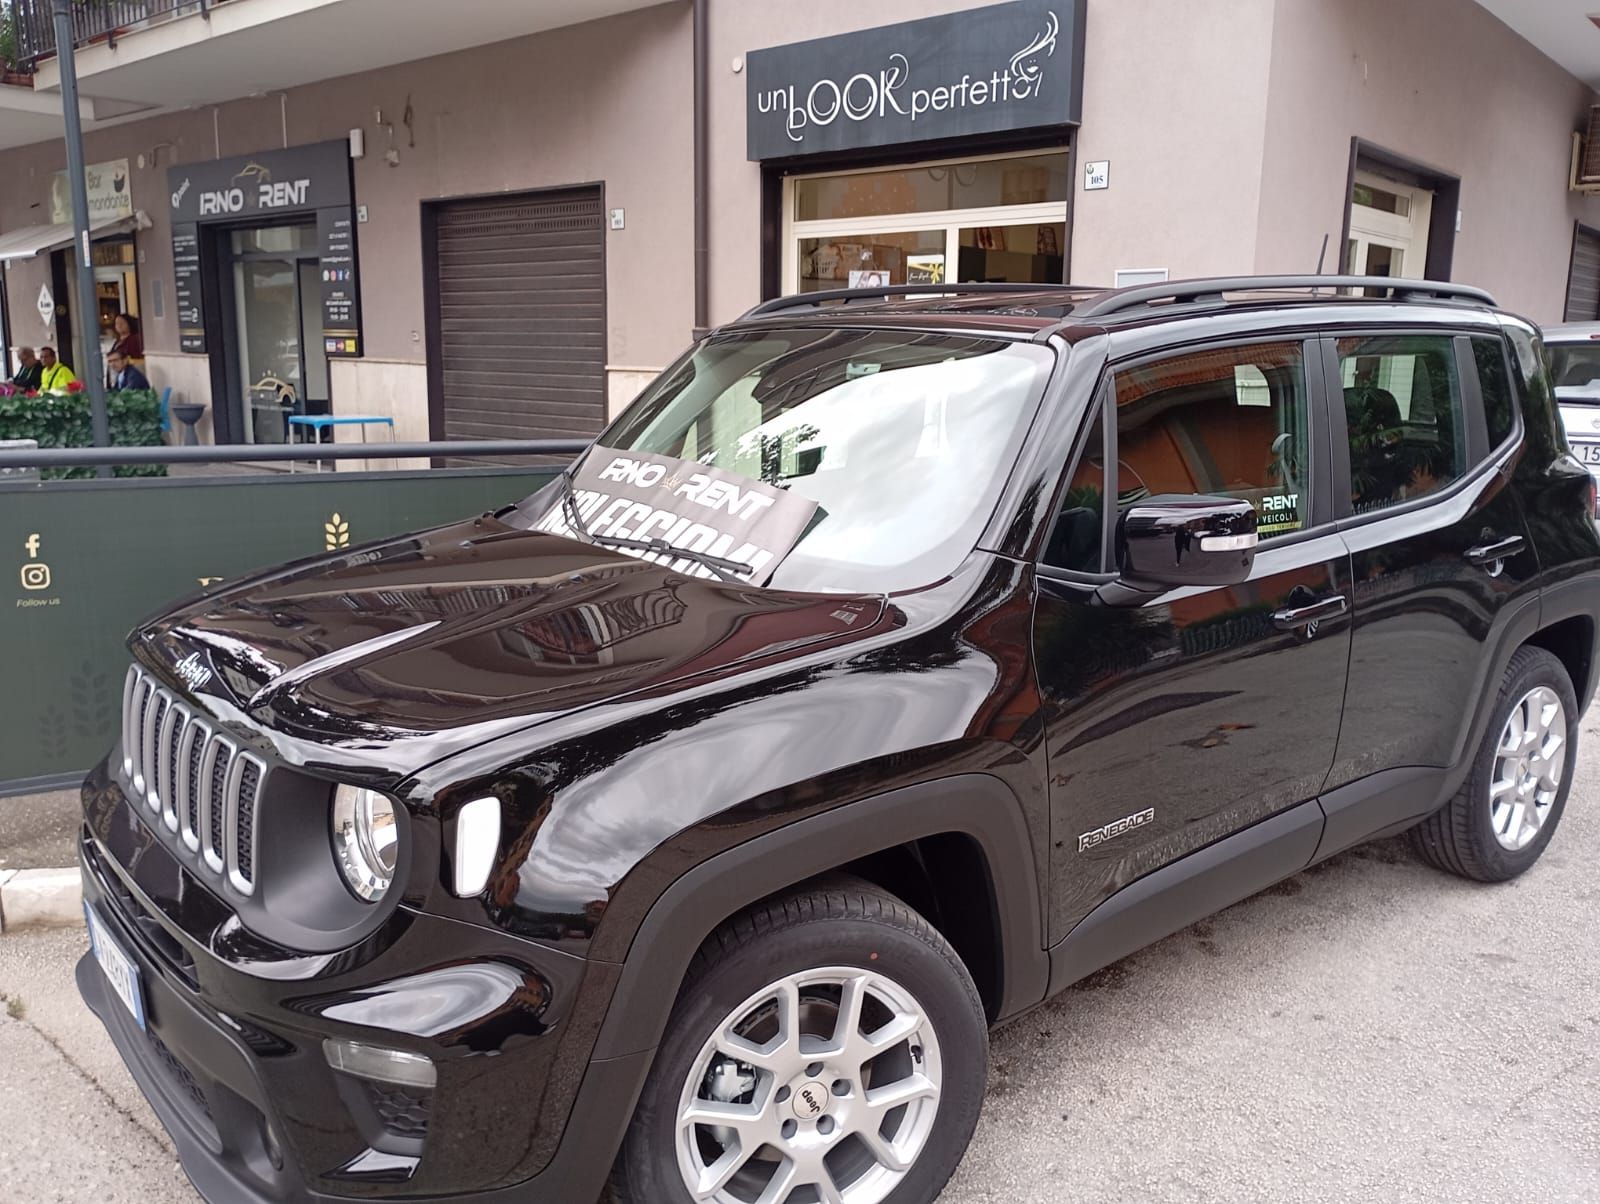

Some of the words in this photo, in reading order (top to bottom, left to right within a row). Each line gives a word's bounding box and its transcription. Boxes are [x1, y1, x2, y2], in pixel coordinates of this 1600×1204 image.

[758, 89, 787, 112] un
[1091, 175, 1104, 185] 105
[200, 188, 244, 216] IRNO
[258, 179, 310, 208] RENT
[673, 473, 776, 521] RENT
[1262, 494, 1298, 512] RENT
[1262, 512, 1293, 524] VEICOLI
[16, 599, 47, 608] Follow
[48, 597, 61, 606] us
[1078, 807, 1155, 853] RENEGADE
[802, 1089, 821, 1113] Jeep
